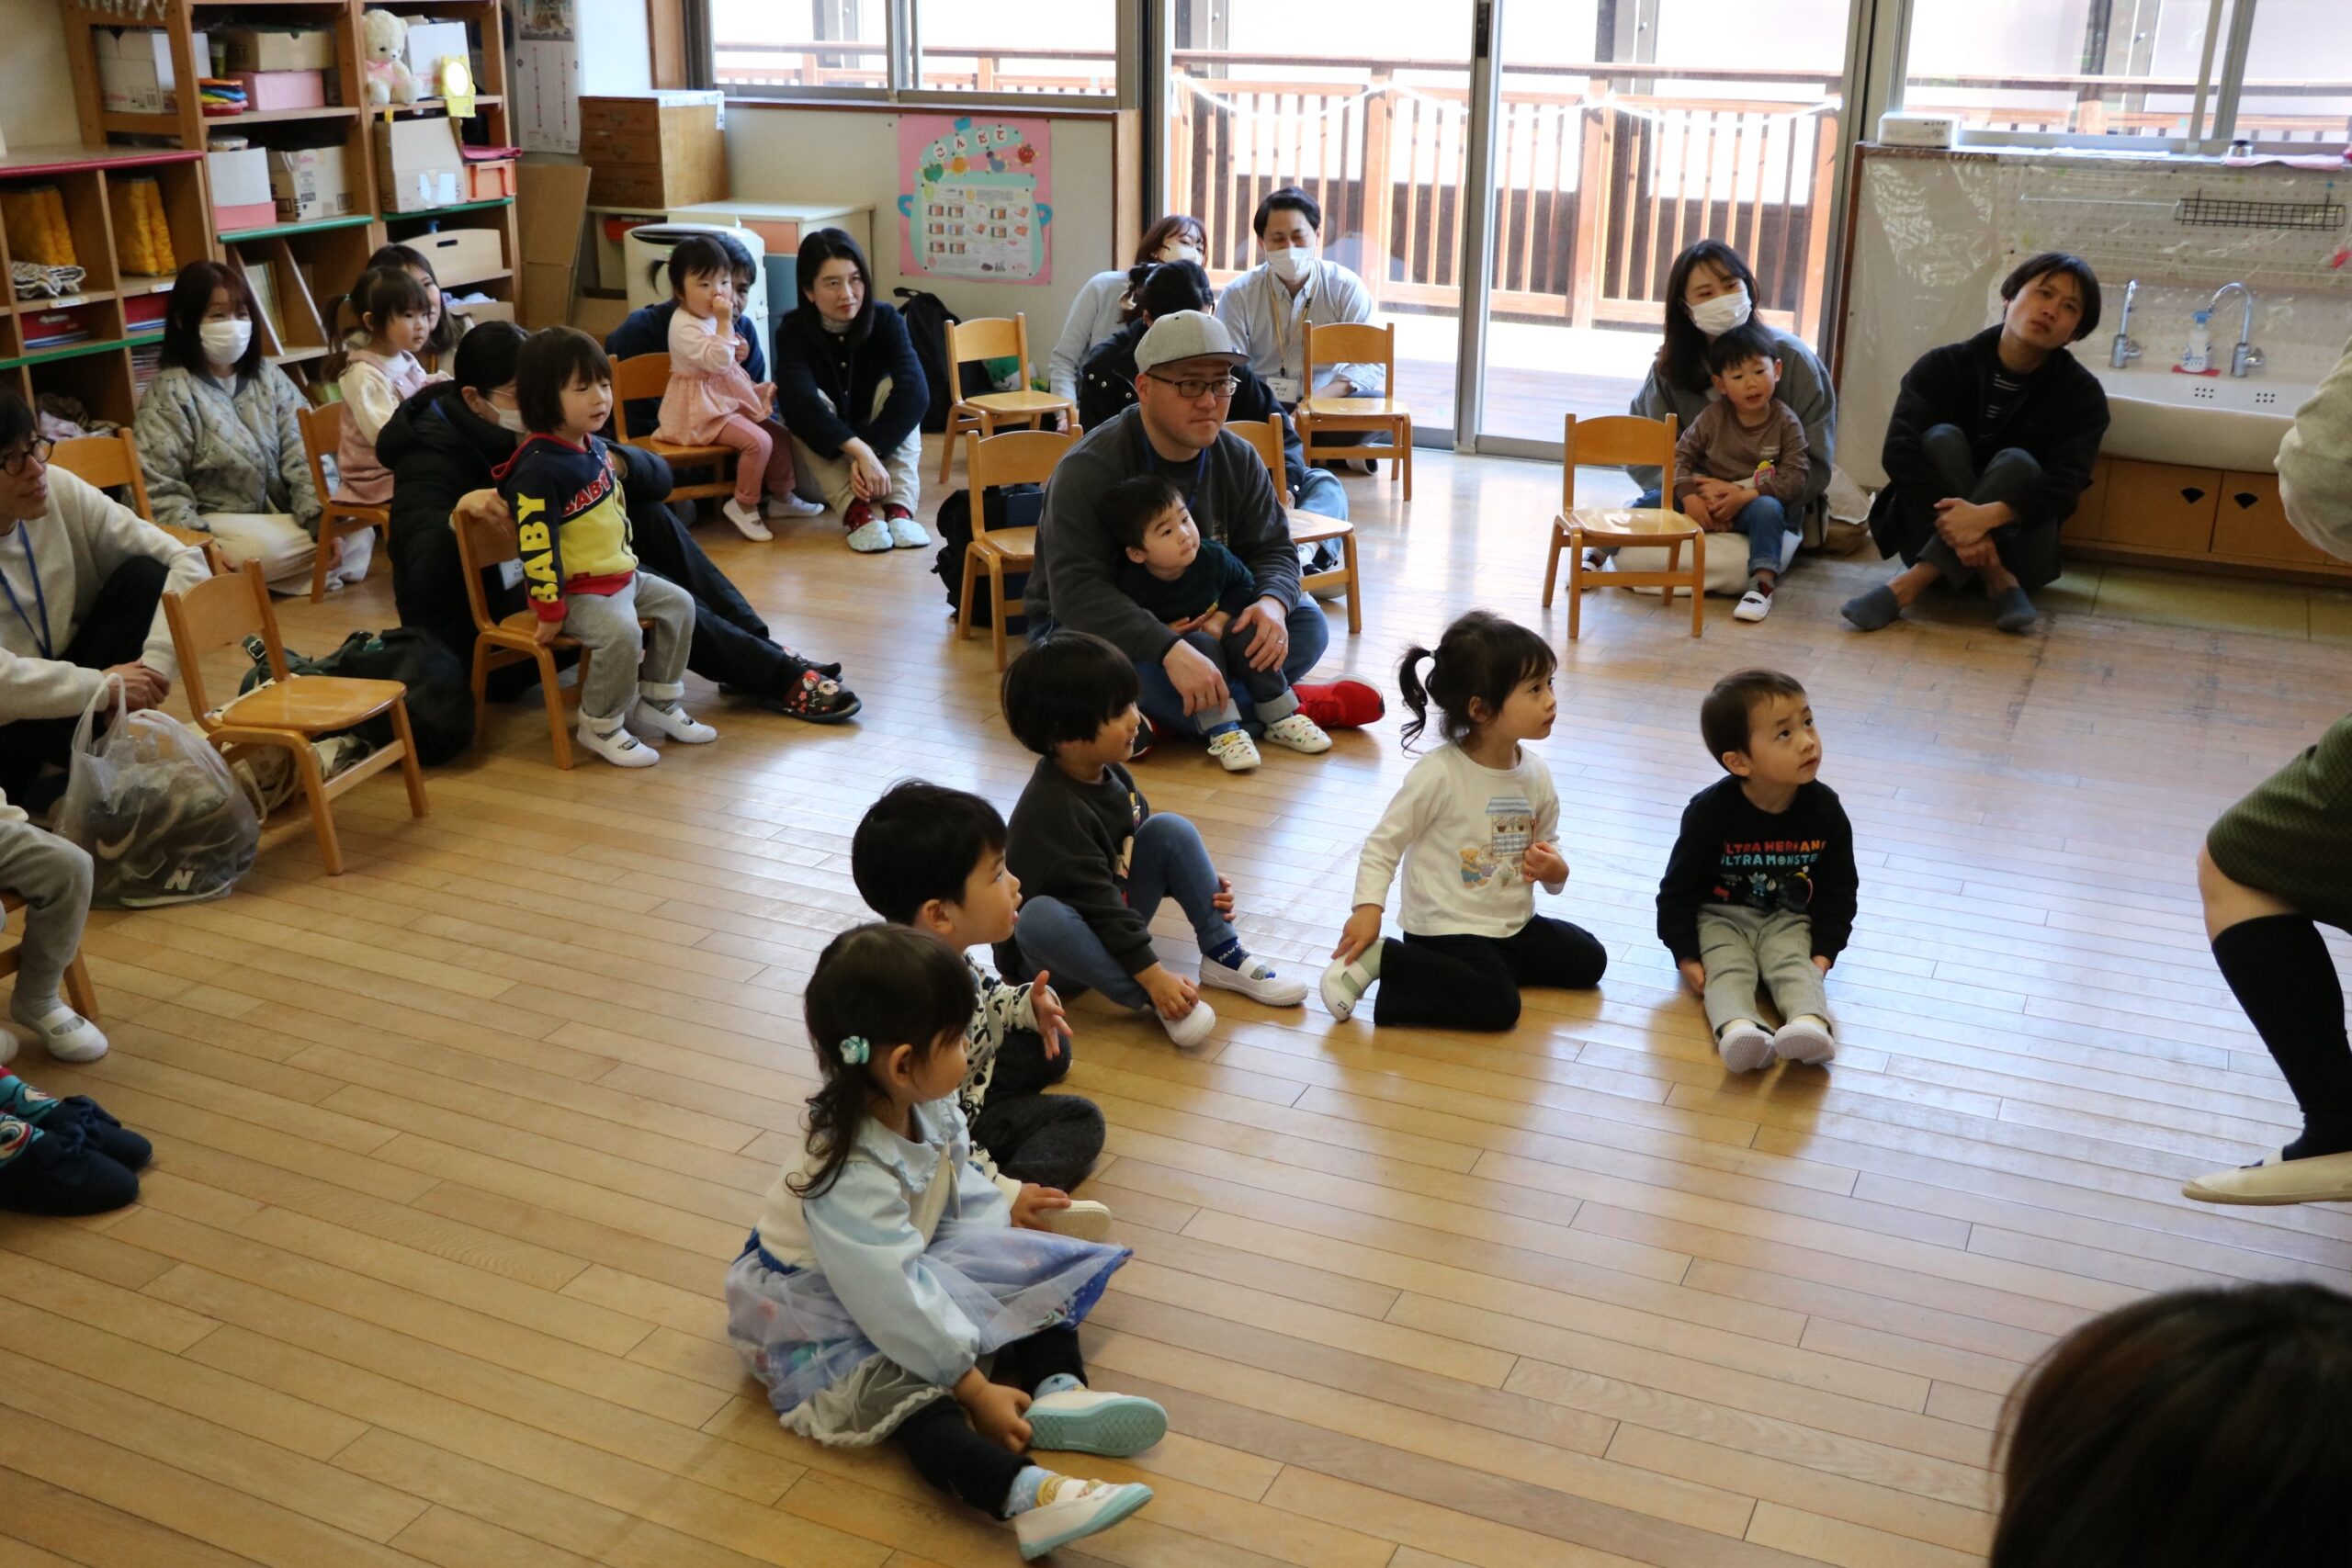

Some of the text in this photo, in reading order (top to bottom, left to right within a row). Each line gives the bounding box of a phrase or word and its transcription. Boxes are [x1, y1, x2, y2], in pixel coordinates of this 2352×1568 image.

[936, 130, 1005, 158] こんだて
[516, 491, 560, 604] BABY
[1724, 840, 1761, 854] LTRA
[164, 869, 195, 891] N
